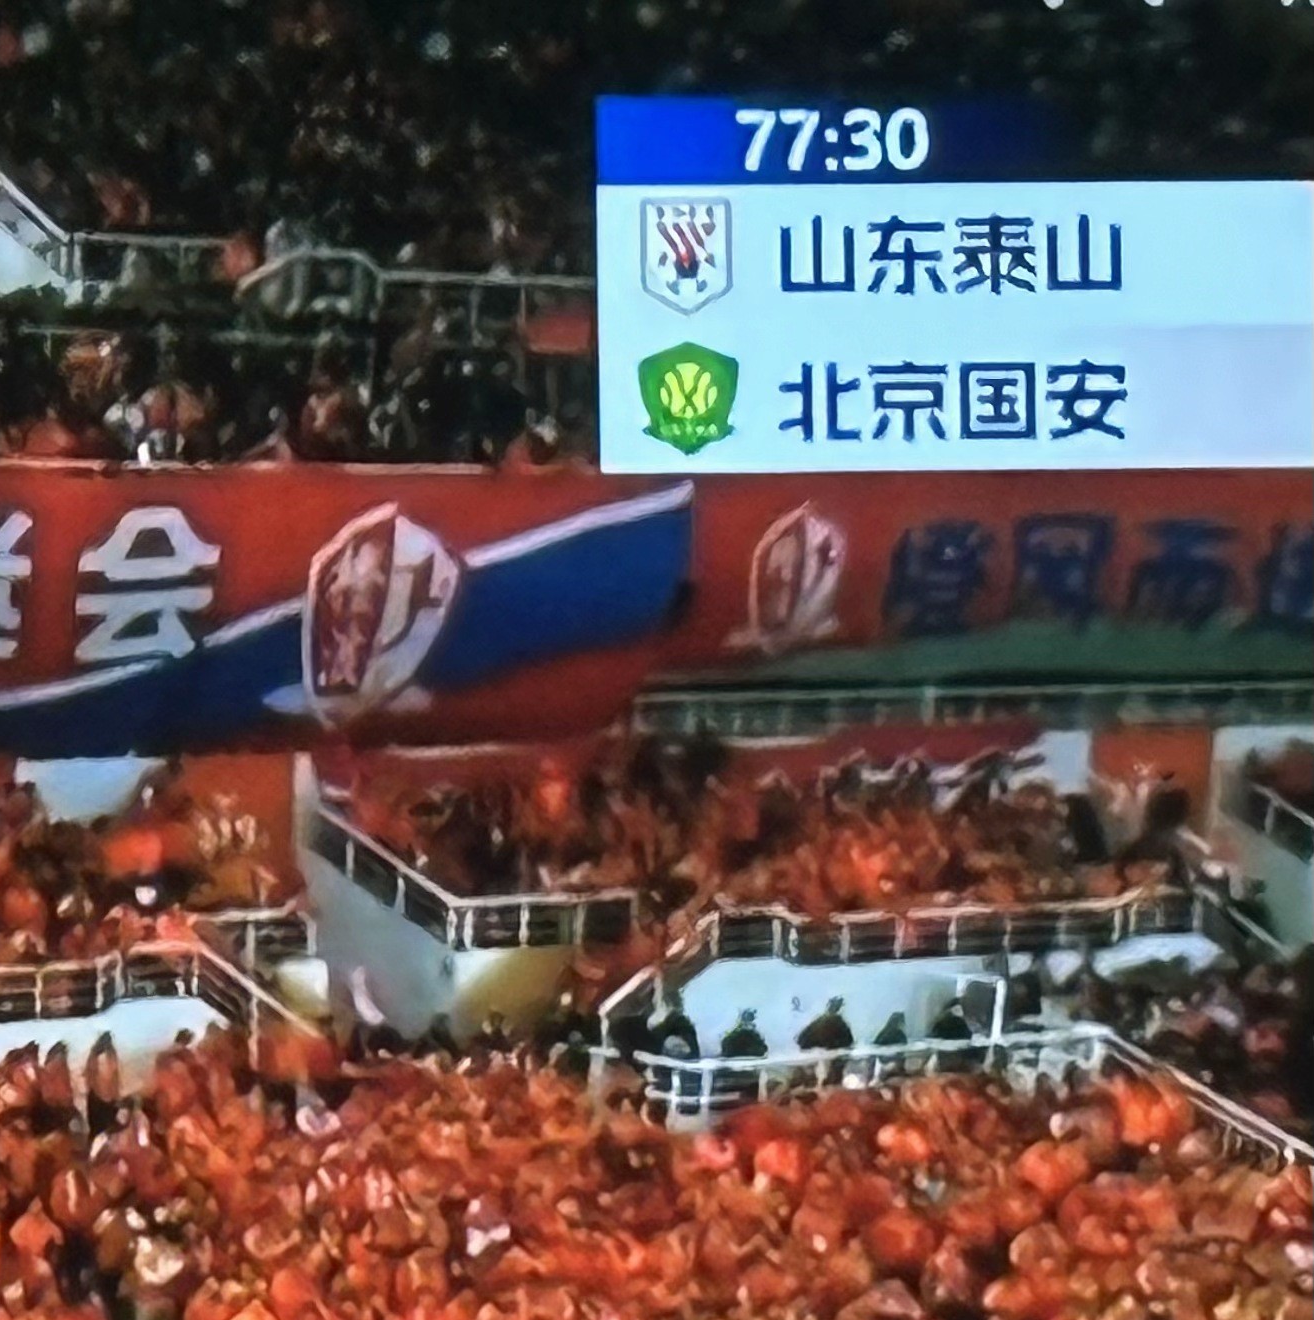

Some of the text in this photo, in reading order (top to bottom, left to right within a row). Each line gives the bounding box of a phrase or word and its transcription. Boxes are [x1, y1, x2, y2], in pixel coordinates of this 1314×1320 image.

[735, 108, 929, 171] 77:30
[780, 213, 1123, 296] 山东泰山
[779, 359, 1129, 443] 北京国安
